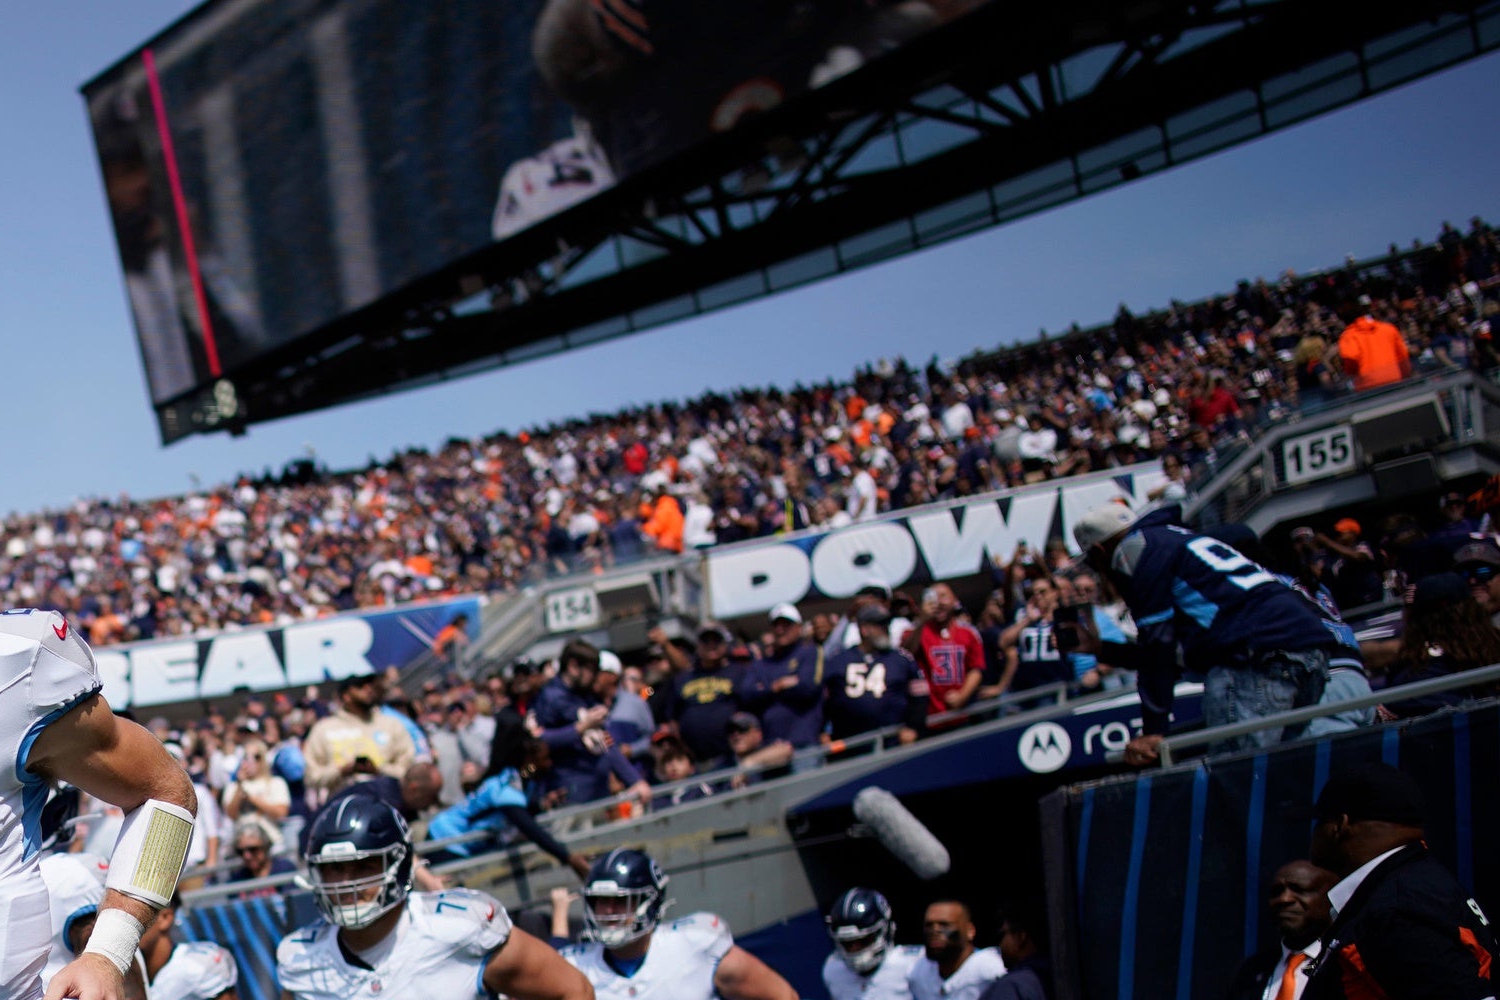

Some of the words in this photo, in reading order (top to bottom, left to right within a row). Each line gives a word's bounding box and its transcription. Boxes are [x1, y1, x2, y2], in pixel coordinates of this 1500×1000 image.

[1288, 432, 1349, 475] 155
[553, 595, 592, 622] 154
[845, 662, 887, 698] 54
[931, 645, 966, 685] 31
